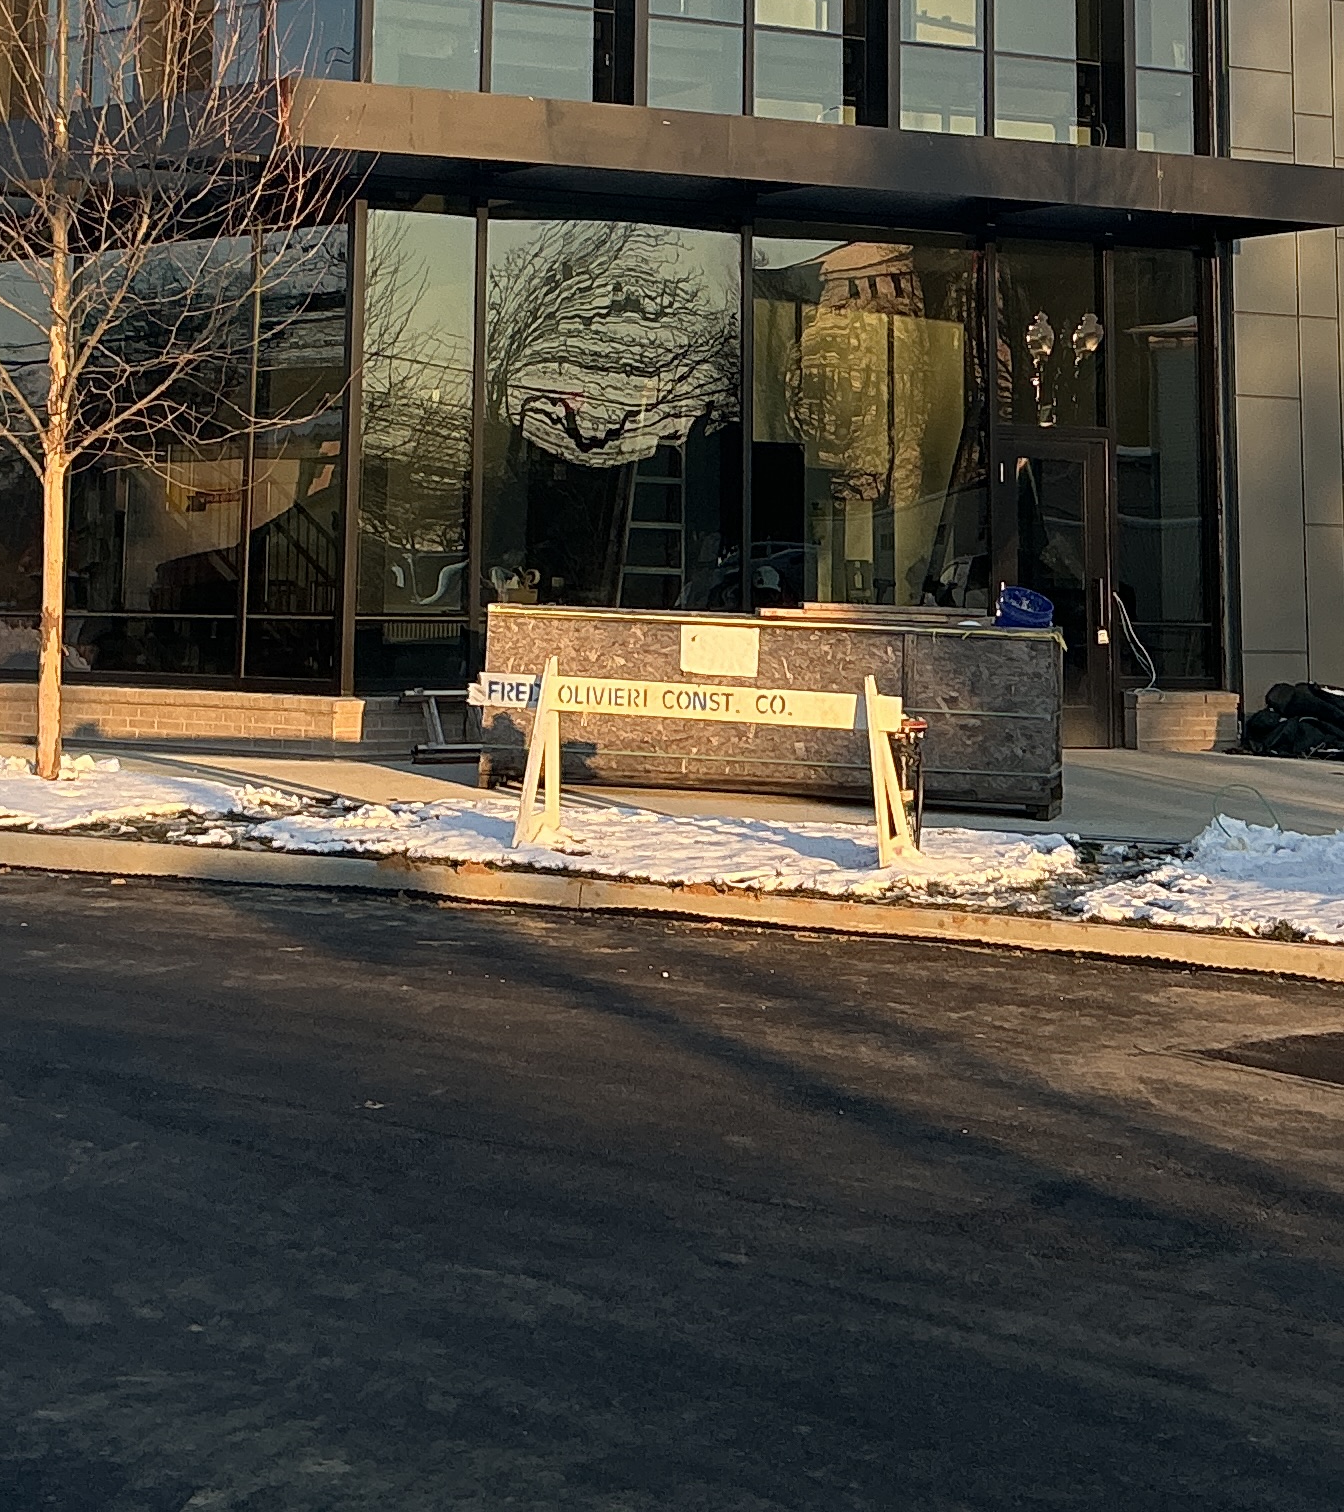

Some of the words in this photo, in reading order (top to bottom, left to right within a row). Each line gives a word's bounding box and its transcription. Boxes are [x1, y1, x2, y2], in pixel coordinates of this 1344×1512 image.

[557, 684, 648, 708] OLIVIERI
[661, 689, 741, 714] CONST.
[755, 694, 793, 716] CO.
